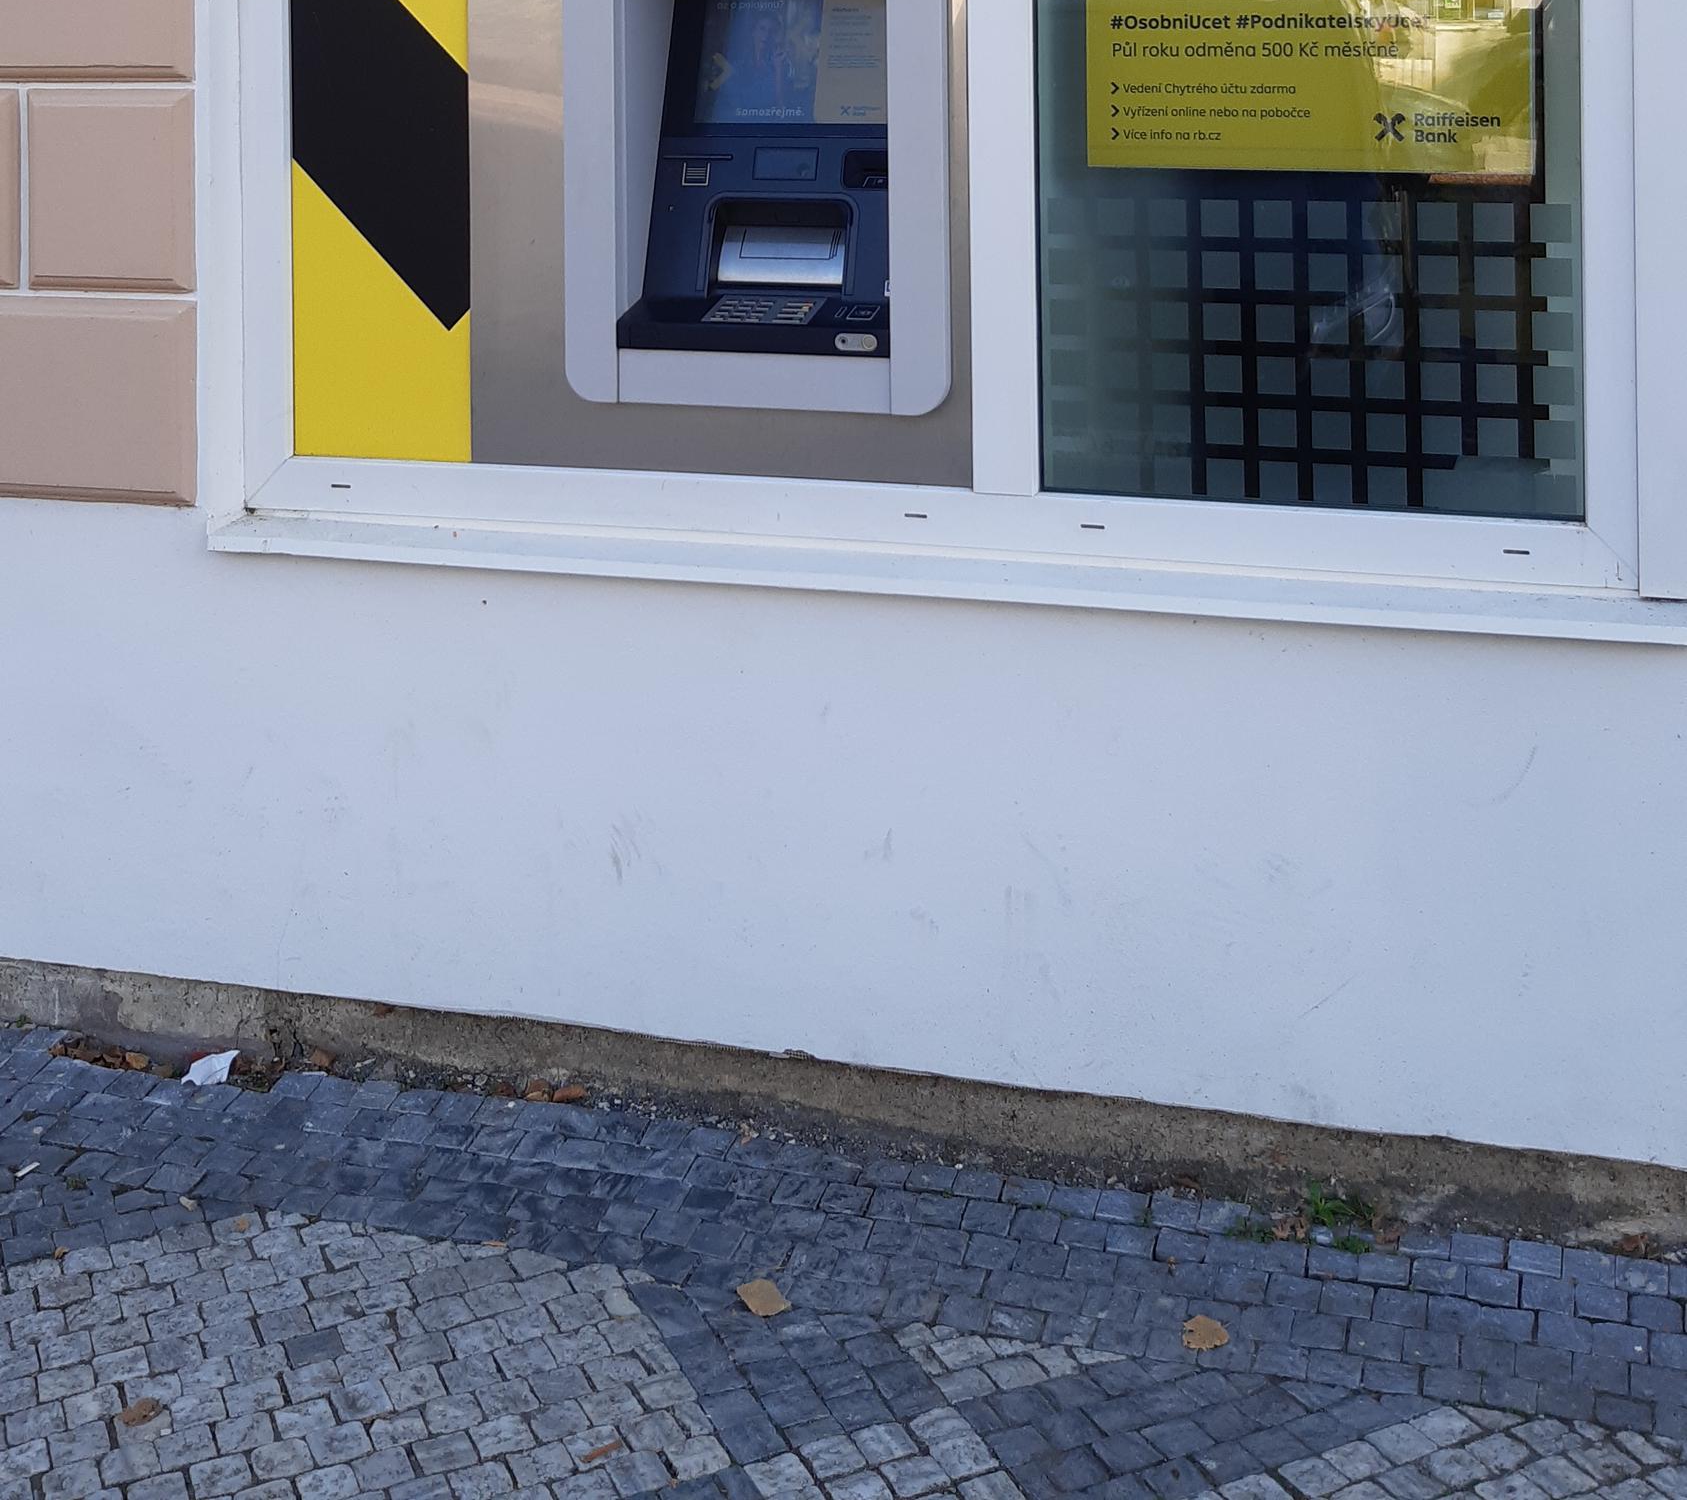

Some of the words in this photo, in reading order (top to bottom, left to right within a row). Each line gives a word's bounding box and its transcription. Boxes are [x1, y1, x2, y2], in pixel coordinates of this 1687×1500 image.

[1110, 14, 1231, 30] #OsobniUcet
[1112, 41, 1137, 57] Půl
[1142, 42, 1179, 57] roku
[1184, 41, 1256, 57] odměna
[1261, 42, 1294, 57] 500
[1299, 41, 1318, 57] Kč
[1324, 41, 1399, 57] měsíčně
[1123, 83, 1162, 94] Vedení
[1164, 83, 1218, 96] Chytrého
[1221, 83, 1247, 95] účtu
[1250, 84, 1297, 95] zdarma
[1123, 106, 1168, 119] Vyřízení
[1171, 106, 1206, 118] online
[1209, 106, 1239, 118] nebo
[1241, 109, 1257, 118] na
[1260, 106, 1311, 120] pobočce
[1414, 112, 1501, 128] Raiffeisen
[1123, 129, 1147, 140] Více
[1150, 129, 1172, 140] info
[1175, 131, 1190, 141] na
[1193, 130, 1222, 141] rb.cz
[1414, 129, 1457, 144] Bank
